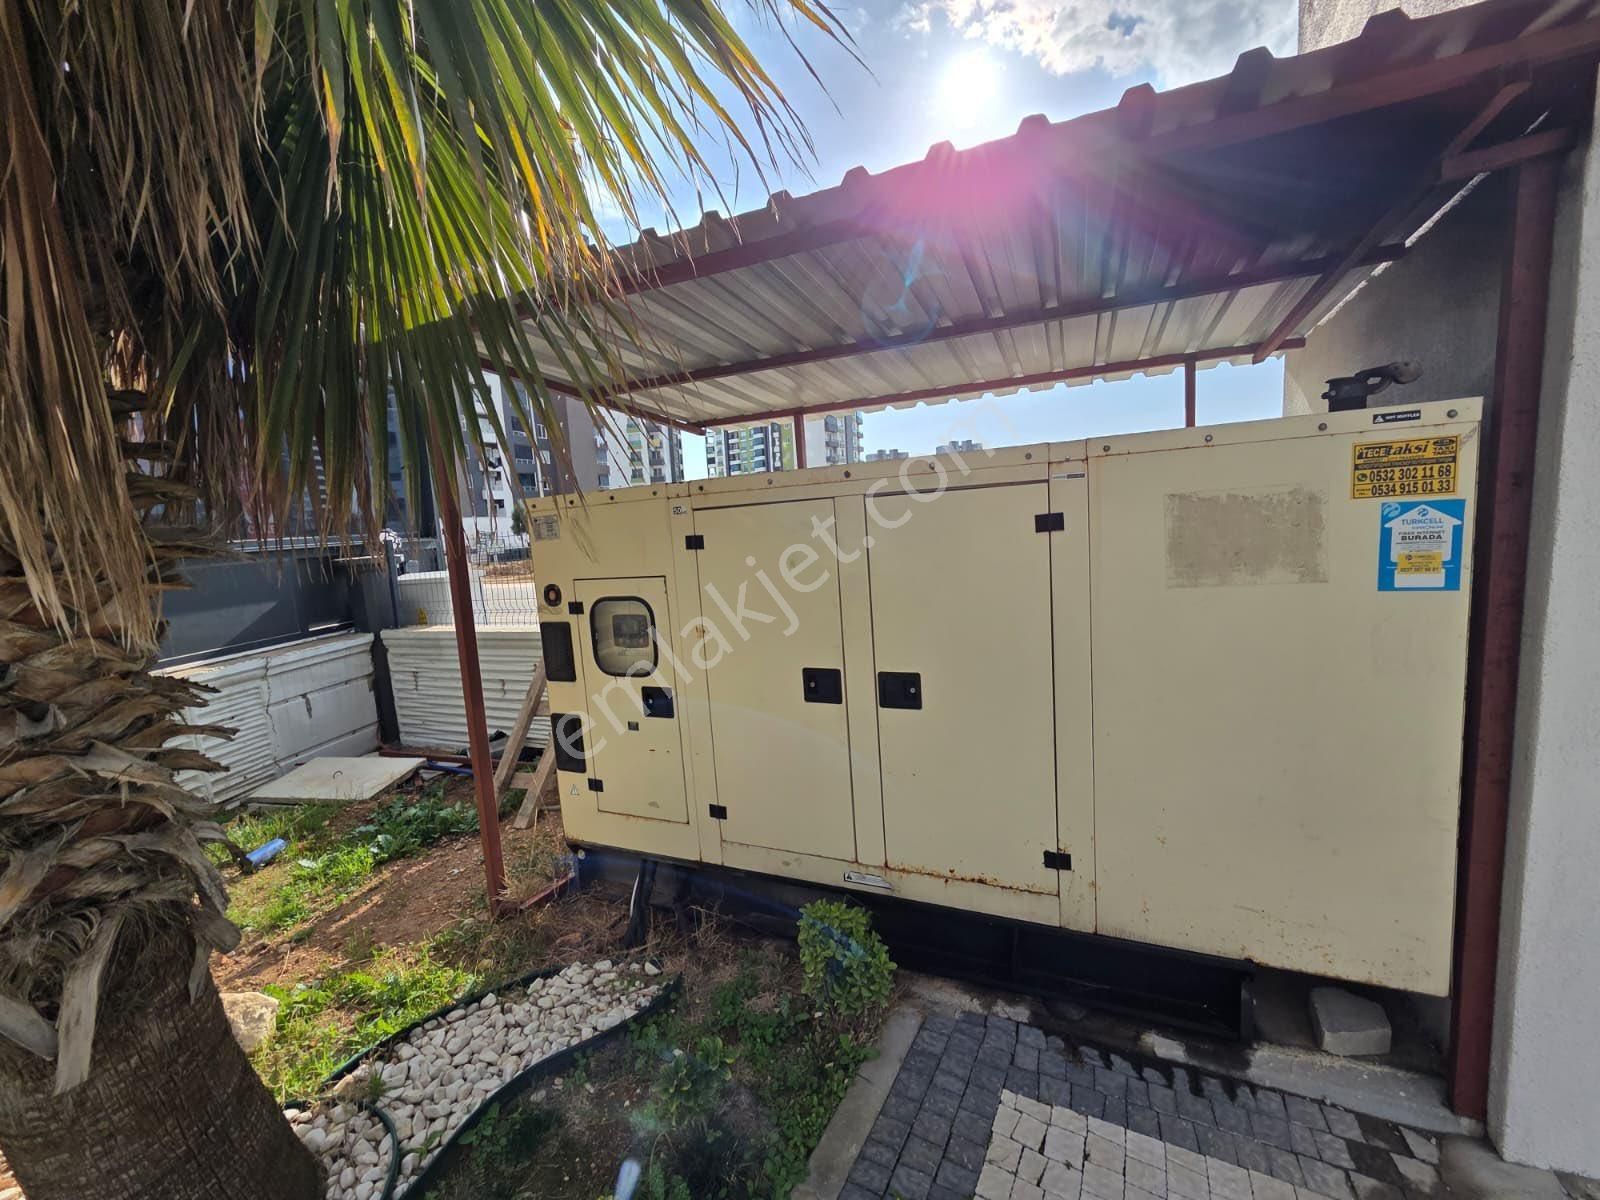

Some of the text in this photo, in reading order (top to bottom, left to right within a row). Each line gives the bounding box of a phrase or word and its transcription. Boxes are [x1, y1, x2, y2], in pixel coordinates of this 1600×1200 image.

[1369, 469, 1395, 482] 0532
[1398, 467, 1418, 480] 302
[1421, 465, 1434, 478] 11
[1437, 464, 1451, 477] 68
[1371, 483, 1396, 496] 0534
[1399, 482, 1418, 494] 915
[1421, 481, 1434, 492] 01
[1437, 479, 1450, 491] 33
